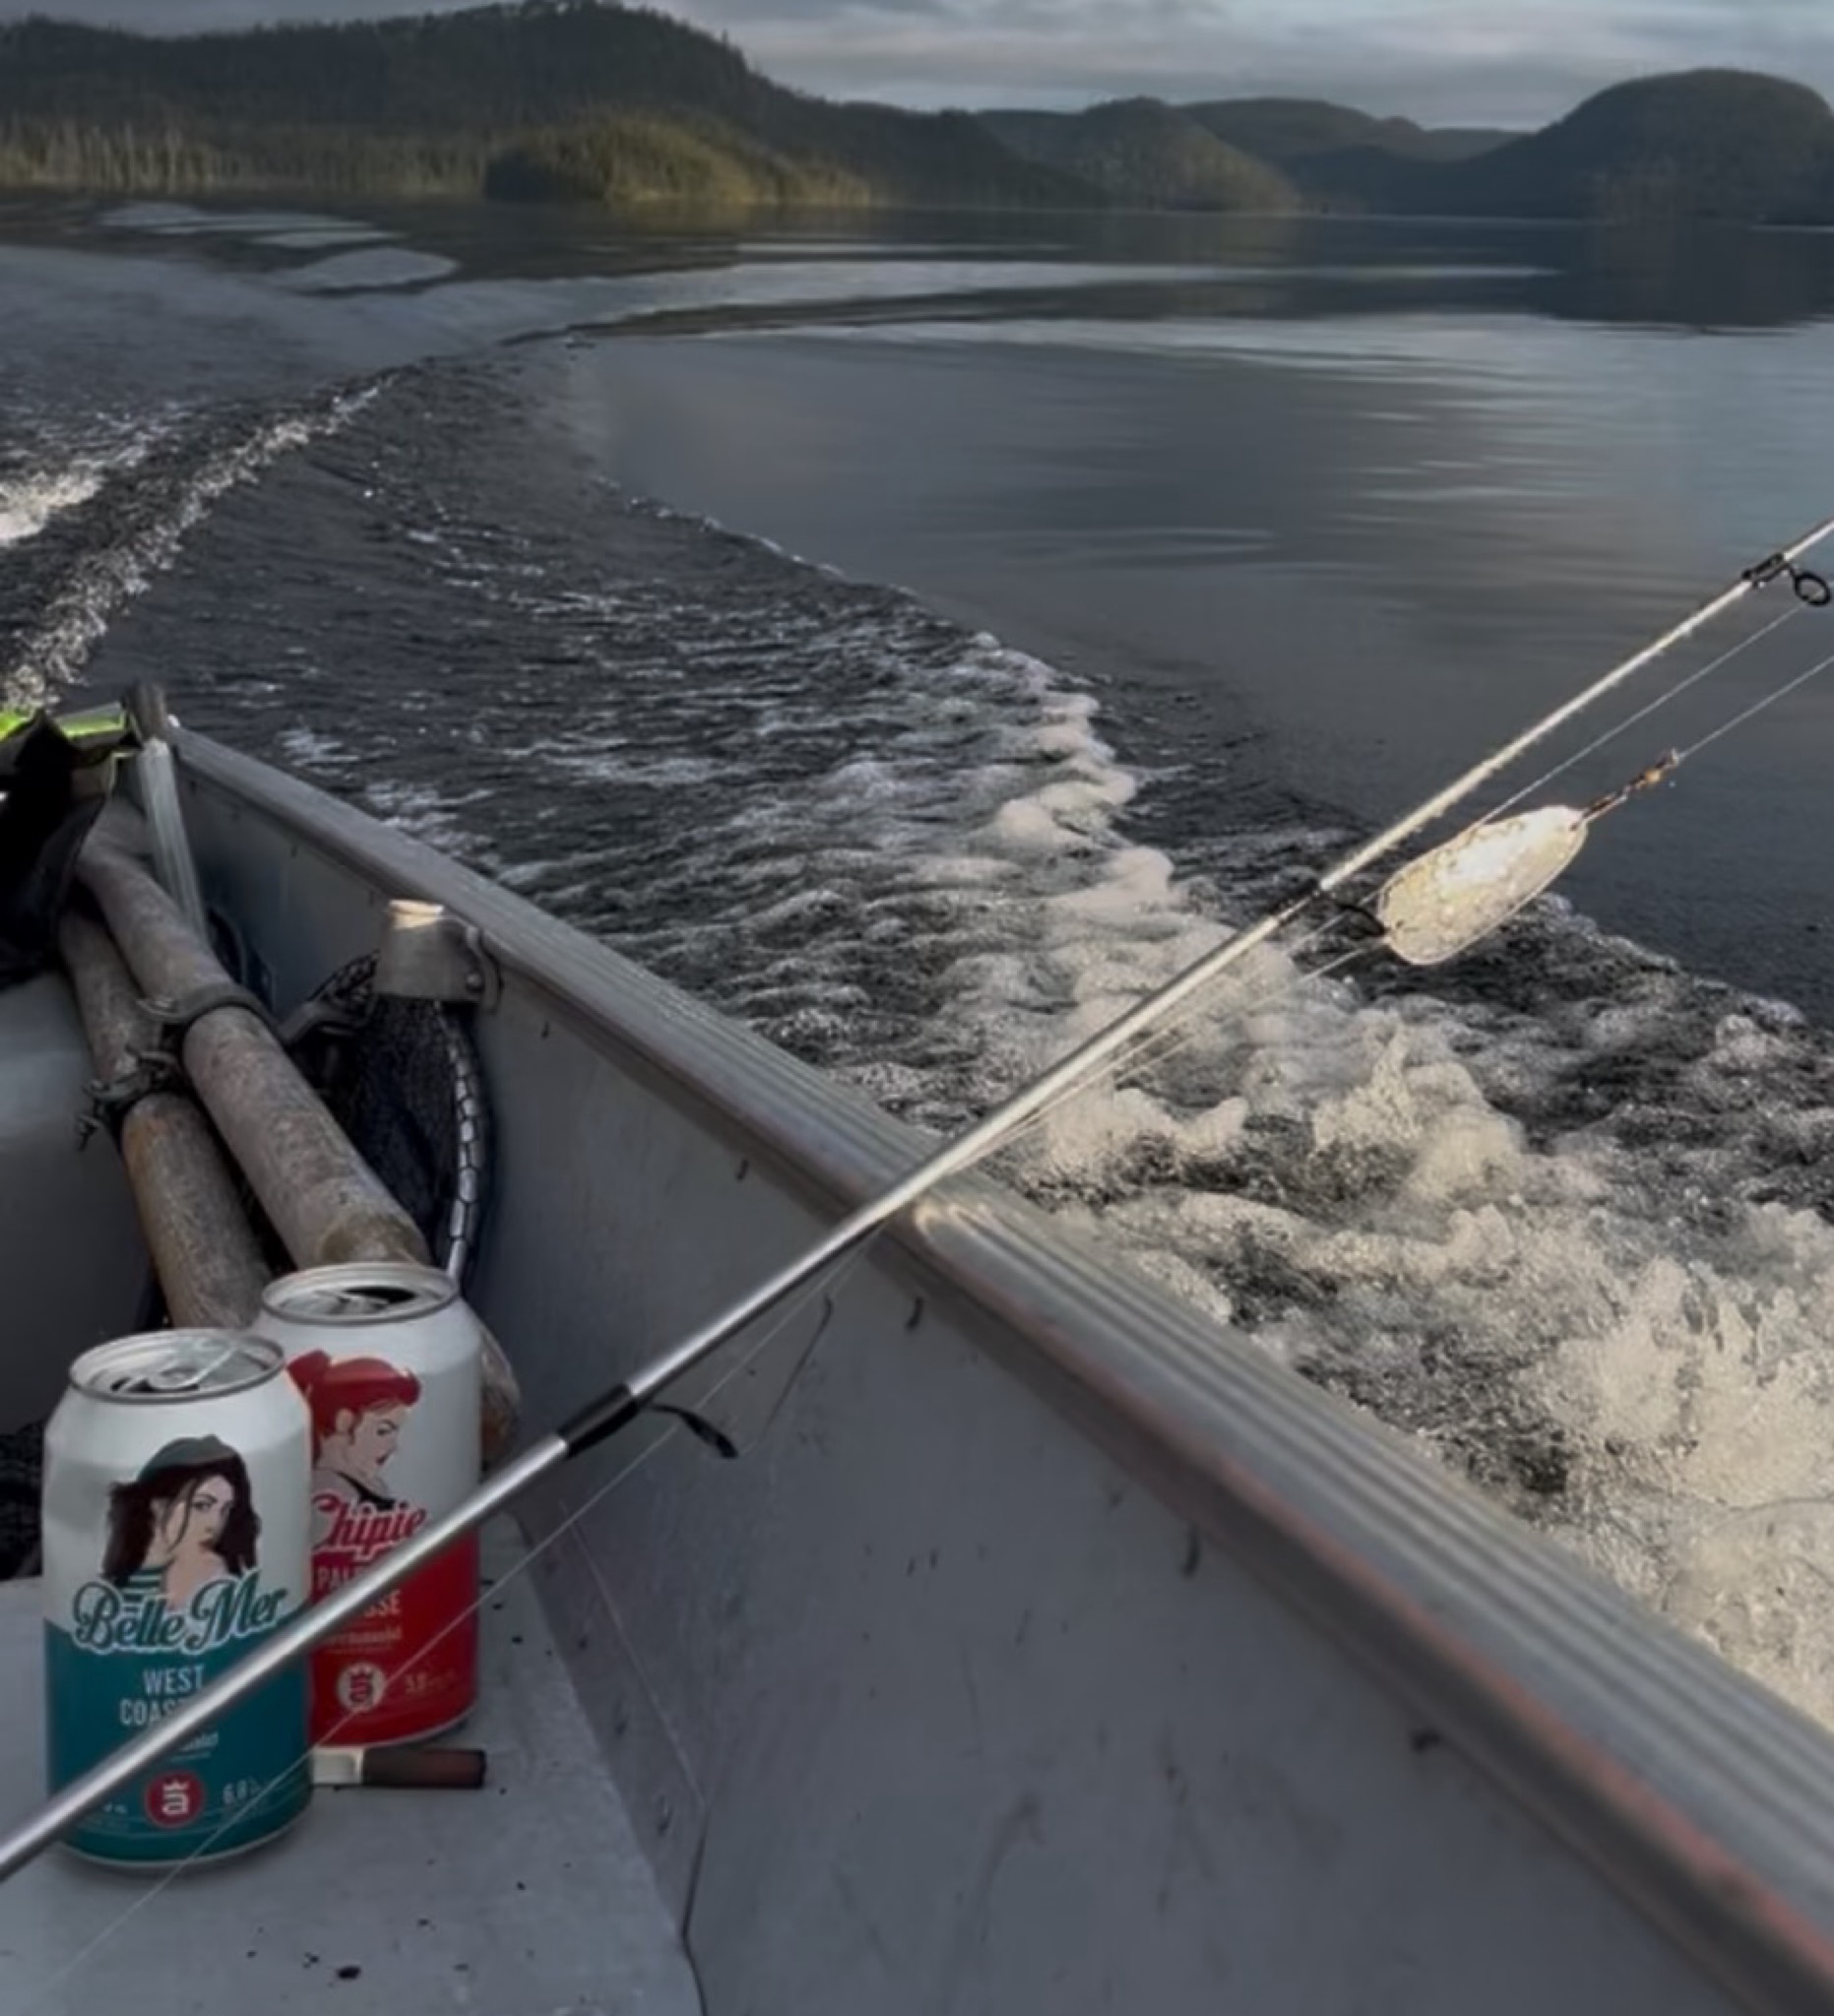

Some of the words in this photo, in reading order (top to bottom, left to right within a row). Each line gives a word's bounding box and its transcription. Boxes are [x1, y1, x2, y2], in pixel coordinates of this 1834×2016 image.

[310, 1492, 427, 1558] Chipie
[72, 1581, 184, 1649] Belle
[184, 1570, 287, 1649] Mer
[143, 1664, 206, 1694] WEST
[119, 1697, 189, 1726] COAS
